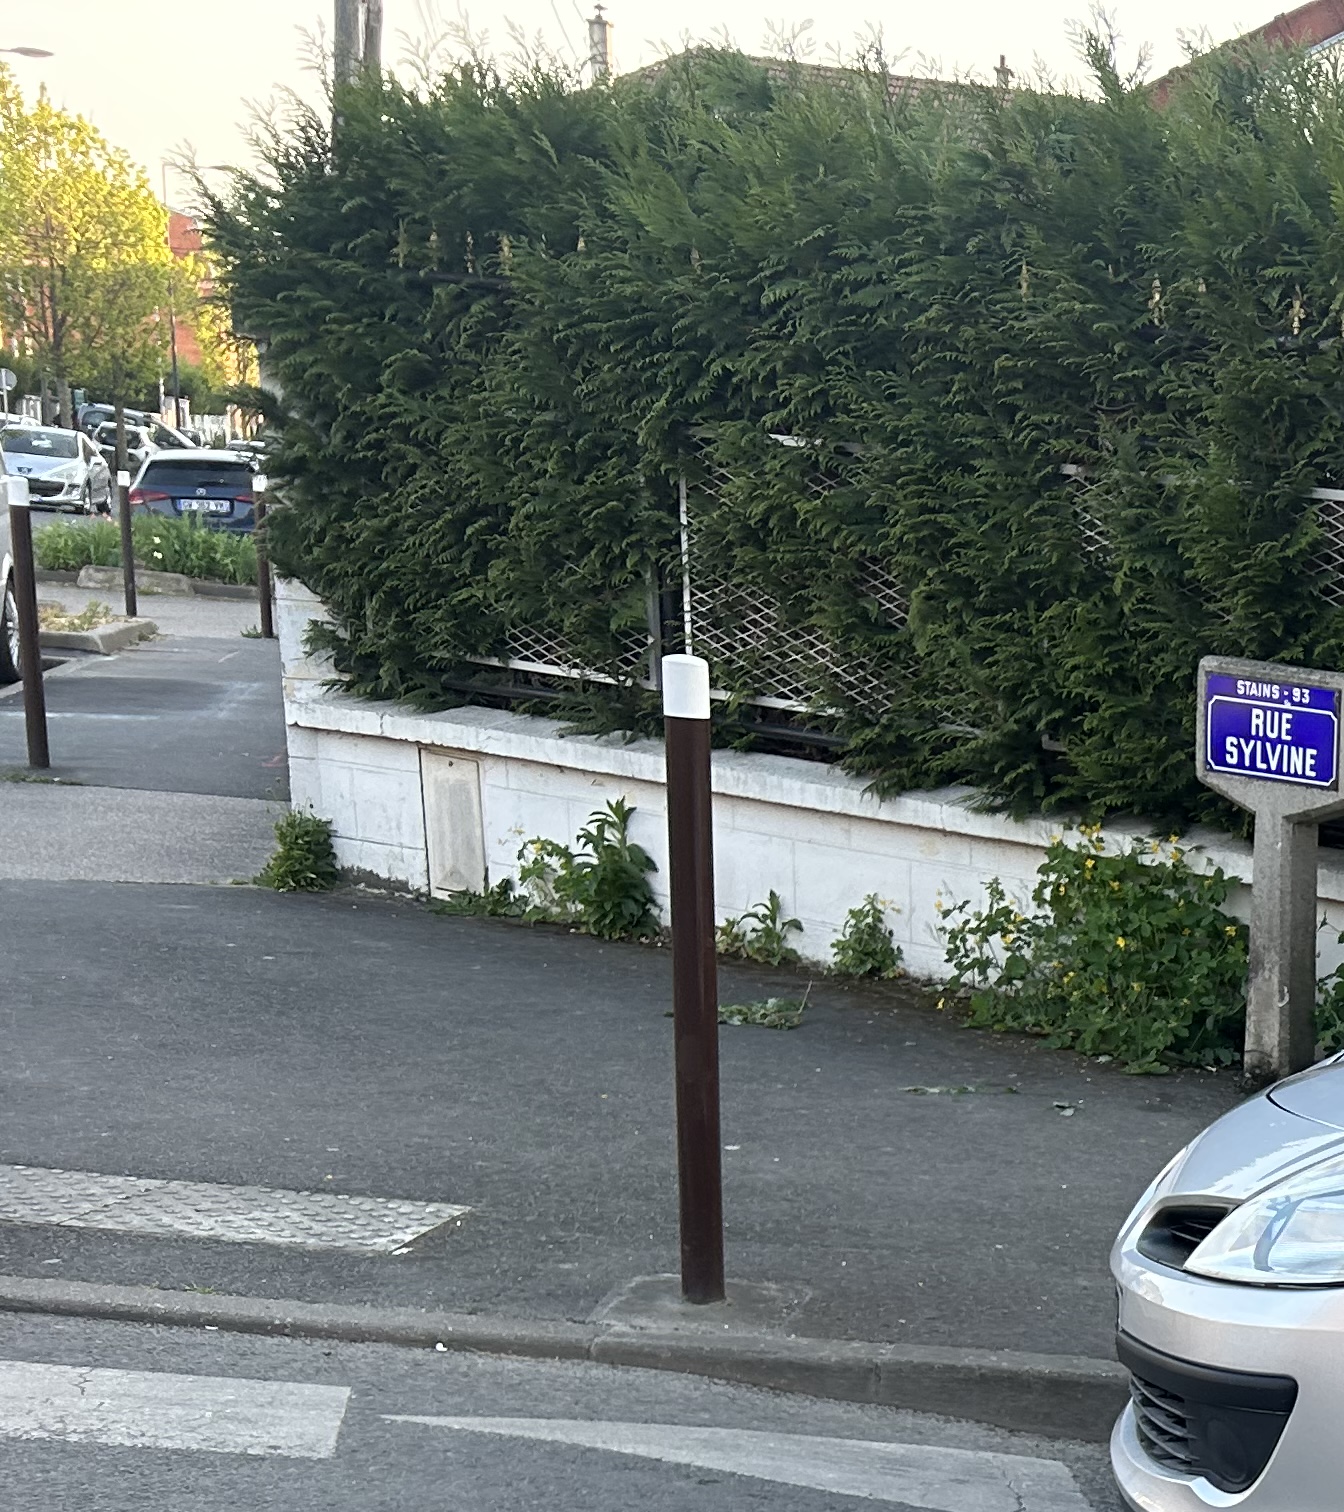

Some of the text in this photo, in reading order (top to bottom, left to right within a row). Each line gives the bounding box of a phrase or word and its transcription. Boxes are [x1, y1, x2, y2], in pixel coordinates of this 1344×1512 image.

[1236, 680, 1280, 699] STAINS
[1292, 687, 1310, 704] 93
[1251, 708, 1293, 741] RUE
[1225, 736, 1318, 777] SYLVINE
